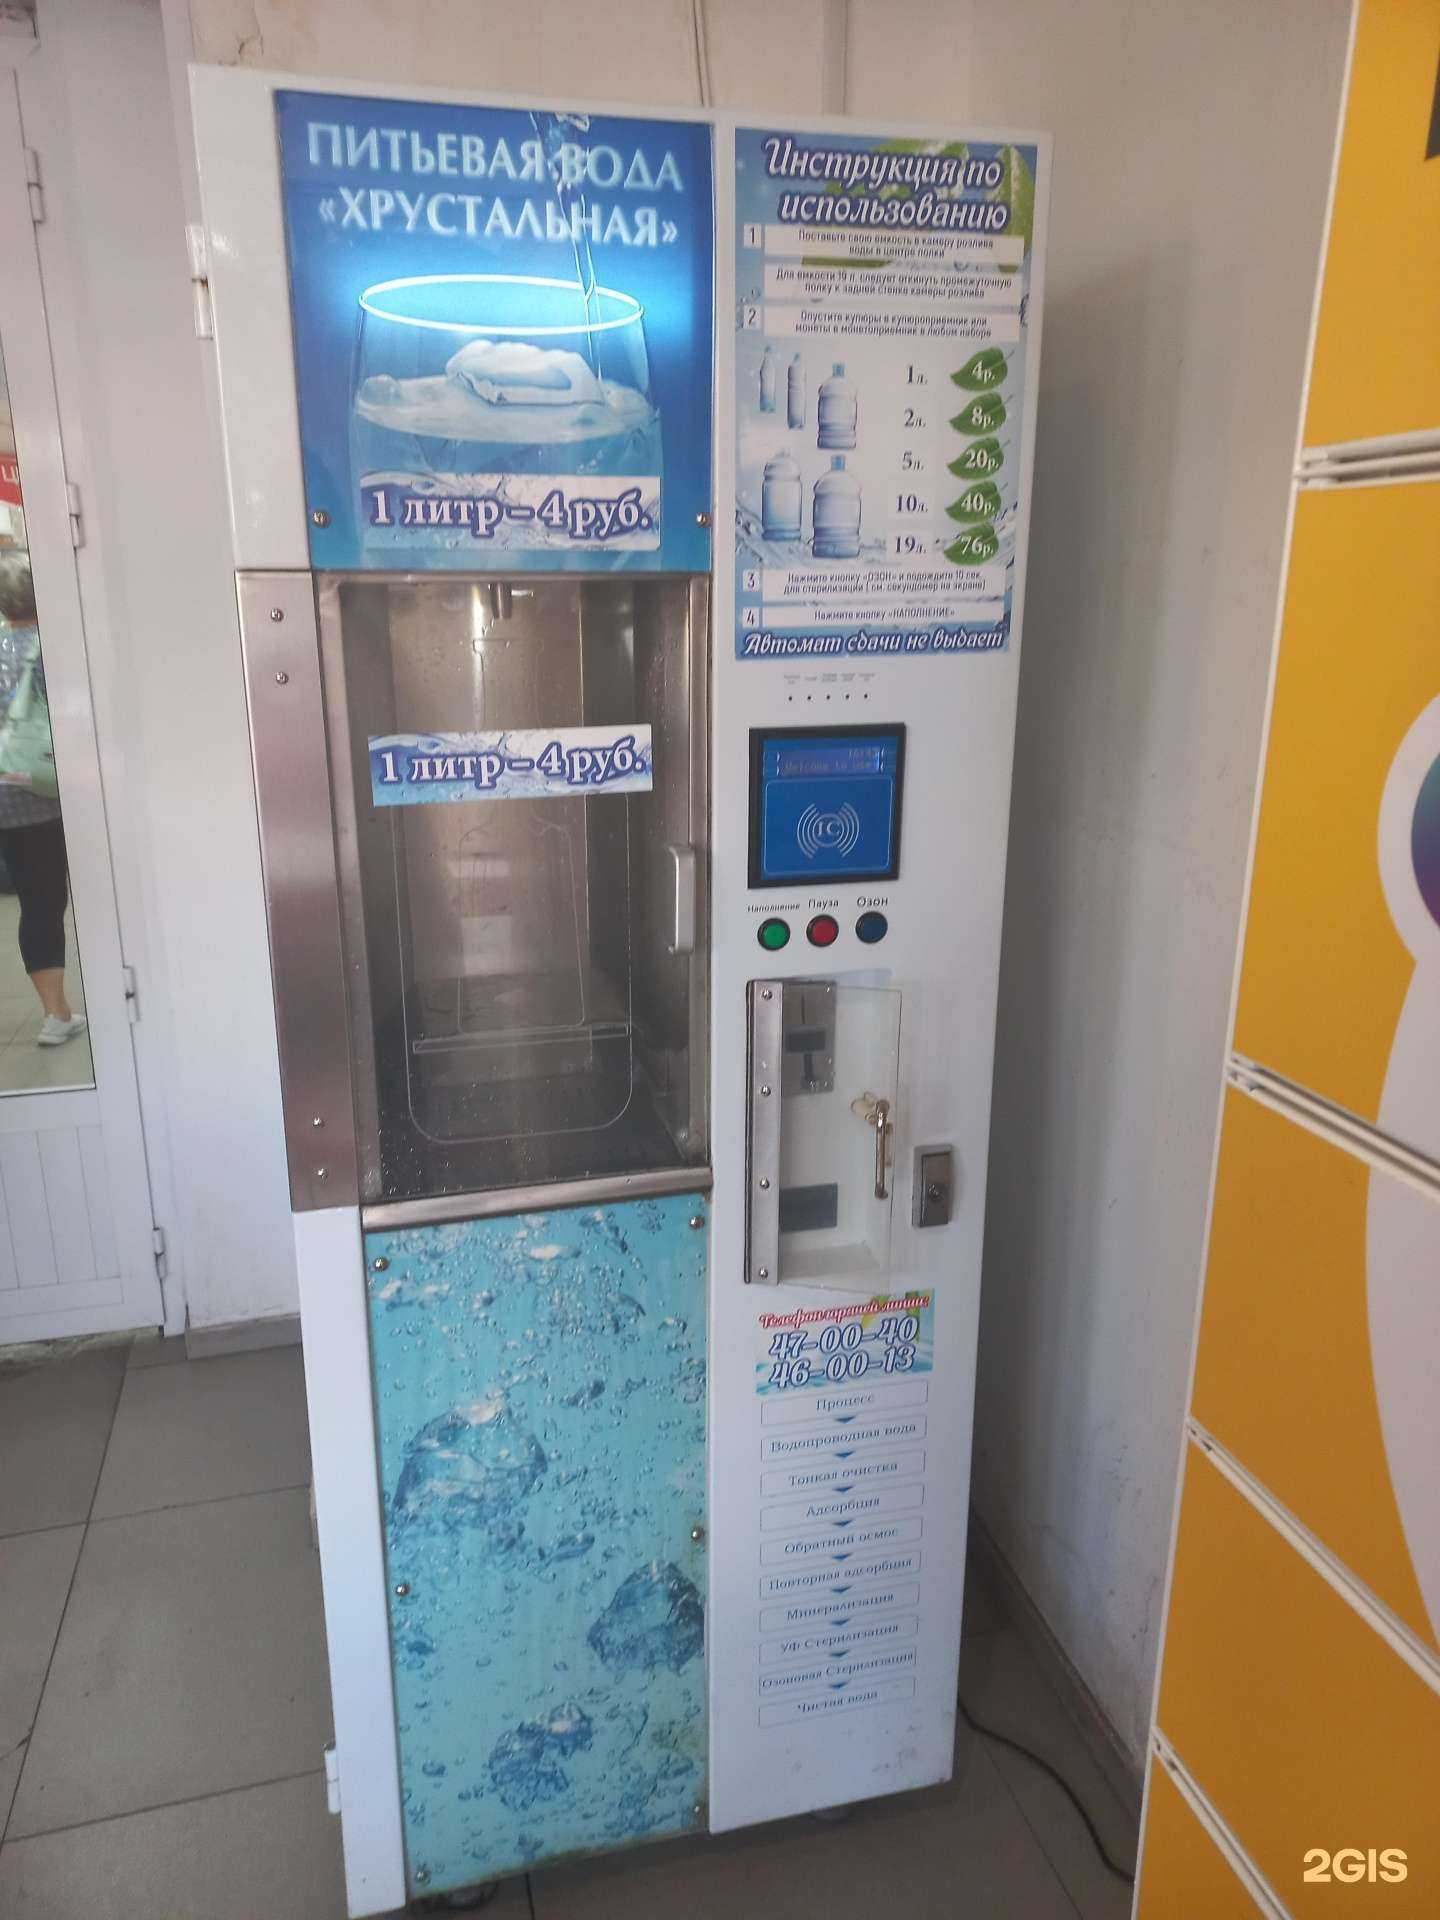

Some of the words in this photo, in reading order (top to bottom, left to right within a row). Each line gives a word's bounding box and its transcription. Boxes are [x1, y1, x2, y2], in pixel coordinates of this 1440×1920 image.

[307, 121, 546, 183] ПИТЬЕВАЯ
[559, 141, 684, 193] ВОДА
[764, 137, 959, 193] Инструкция
[965, 159, 1002, 189] по
[319, 185, 679, 248] «ХРУСТАЛЬНАЯ»
[780, 191, 1008, 231] использованию
[749, 226, 757, 245] 1
[748, 306, 757, 326] 2
[372, 488, 392, 525] 1
[403, 497, 500, 537] литр
[572, 490, 650, 538] руб.
[744, 632, 842, 655] Автомат
[846, 630, 901, 653] сдачи
[906, 633, 929, 651] не
[932, 628, 1004, 649] выдает
[381, 751, 400, 783] 1
[410, 754, 502, 788] литр
[570, 737, 645, 783] руб.
[747, 902, 801, 914] Наполнение
[807, 898, 839, 911] Пауза
[768, 1315, 919, 1360] 47-00-40
[768, 1343, 917, 1389] 46-00-13
[815, 1393, 875, 1413] Процесс
[770, 1427, 880, 1454] Водопроводная
[884, 1423, 917, 1437] вода
[788, 1471, 838, 1487] Тонкая
[842, 1462, 899, 1479] очистка
[784, 1533, 855, 1555] Обратный
[859, 1527, 898, 1543] осмос
[769, 1570, 841, 1592] Повторная
[786, 1592, 895, 1621] Минерализация
[804, 1623, 900, 1649] Стерилизация
[825, 1651, 914, 1677] Стерилизация
[797, 1696, 844, 1713] Чистая
